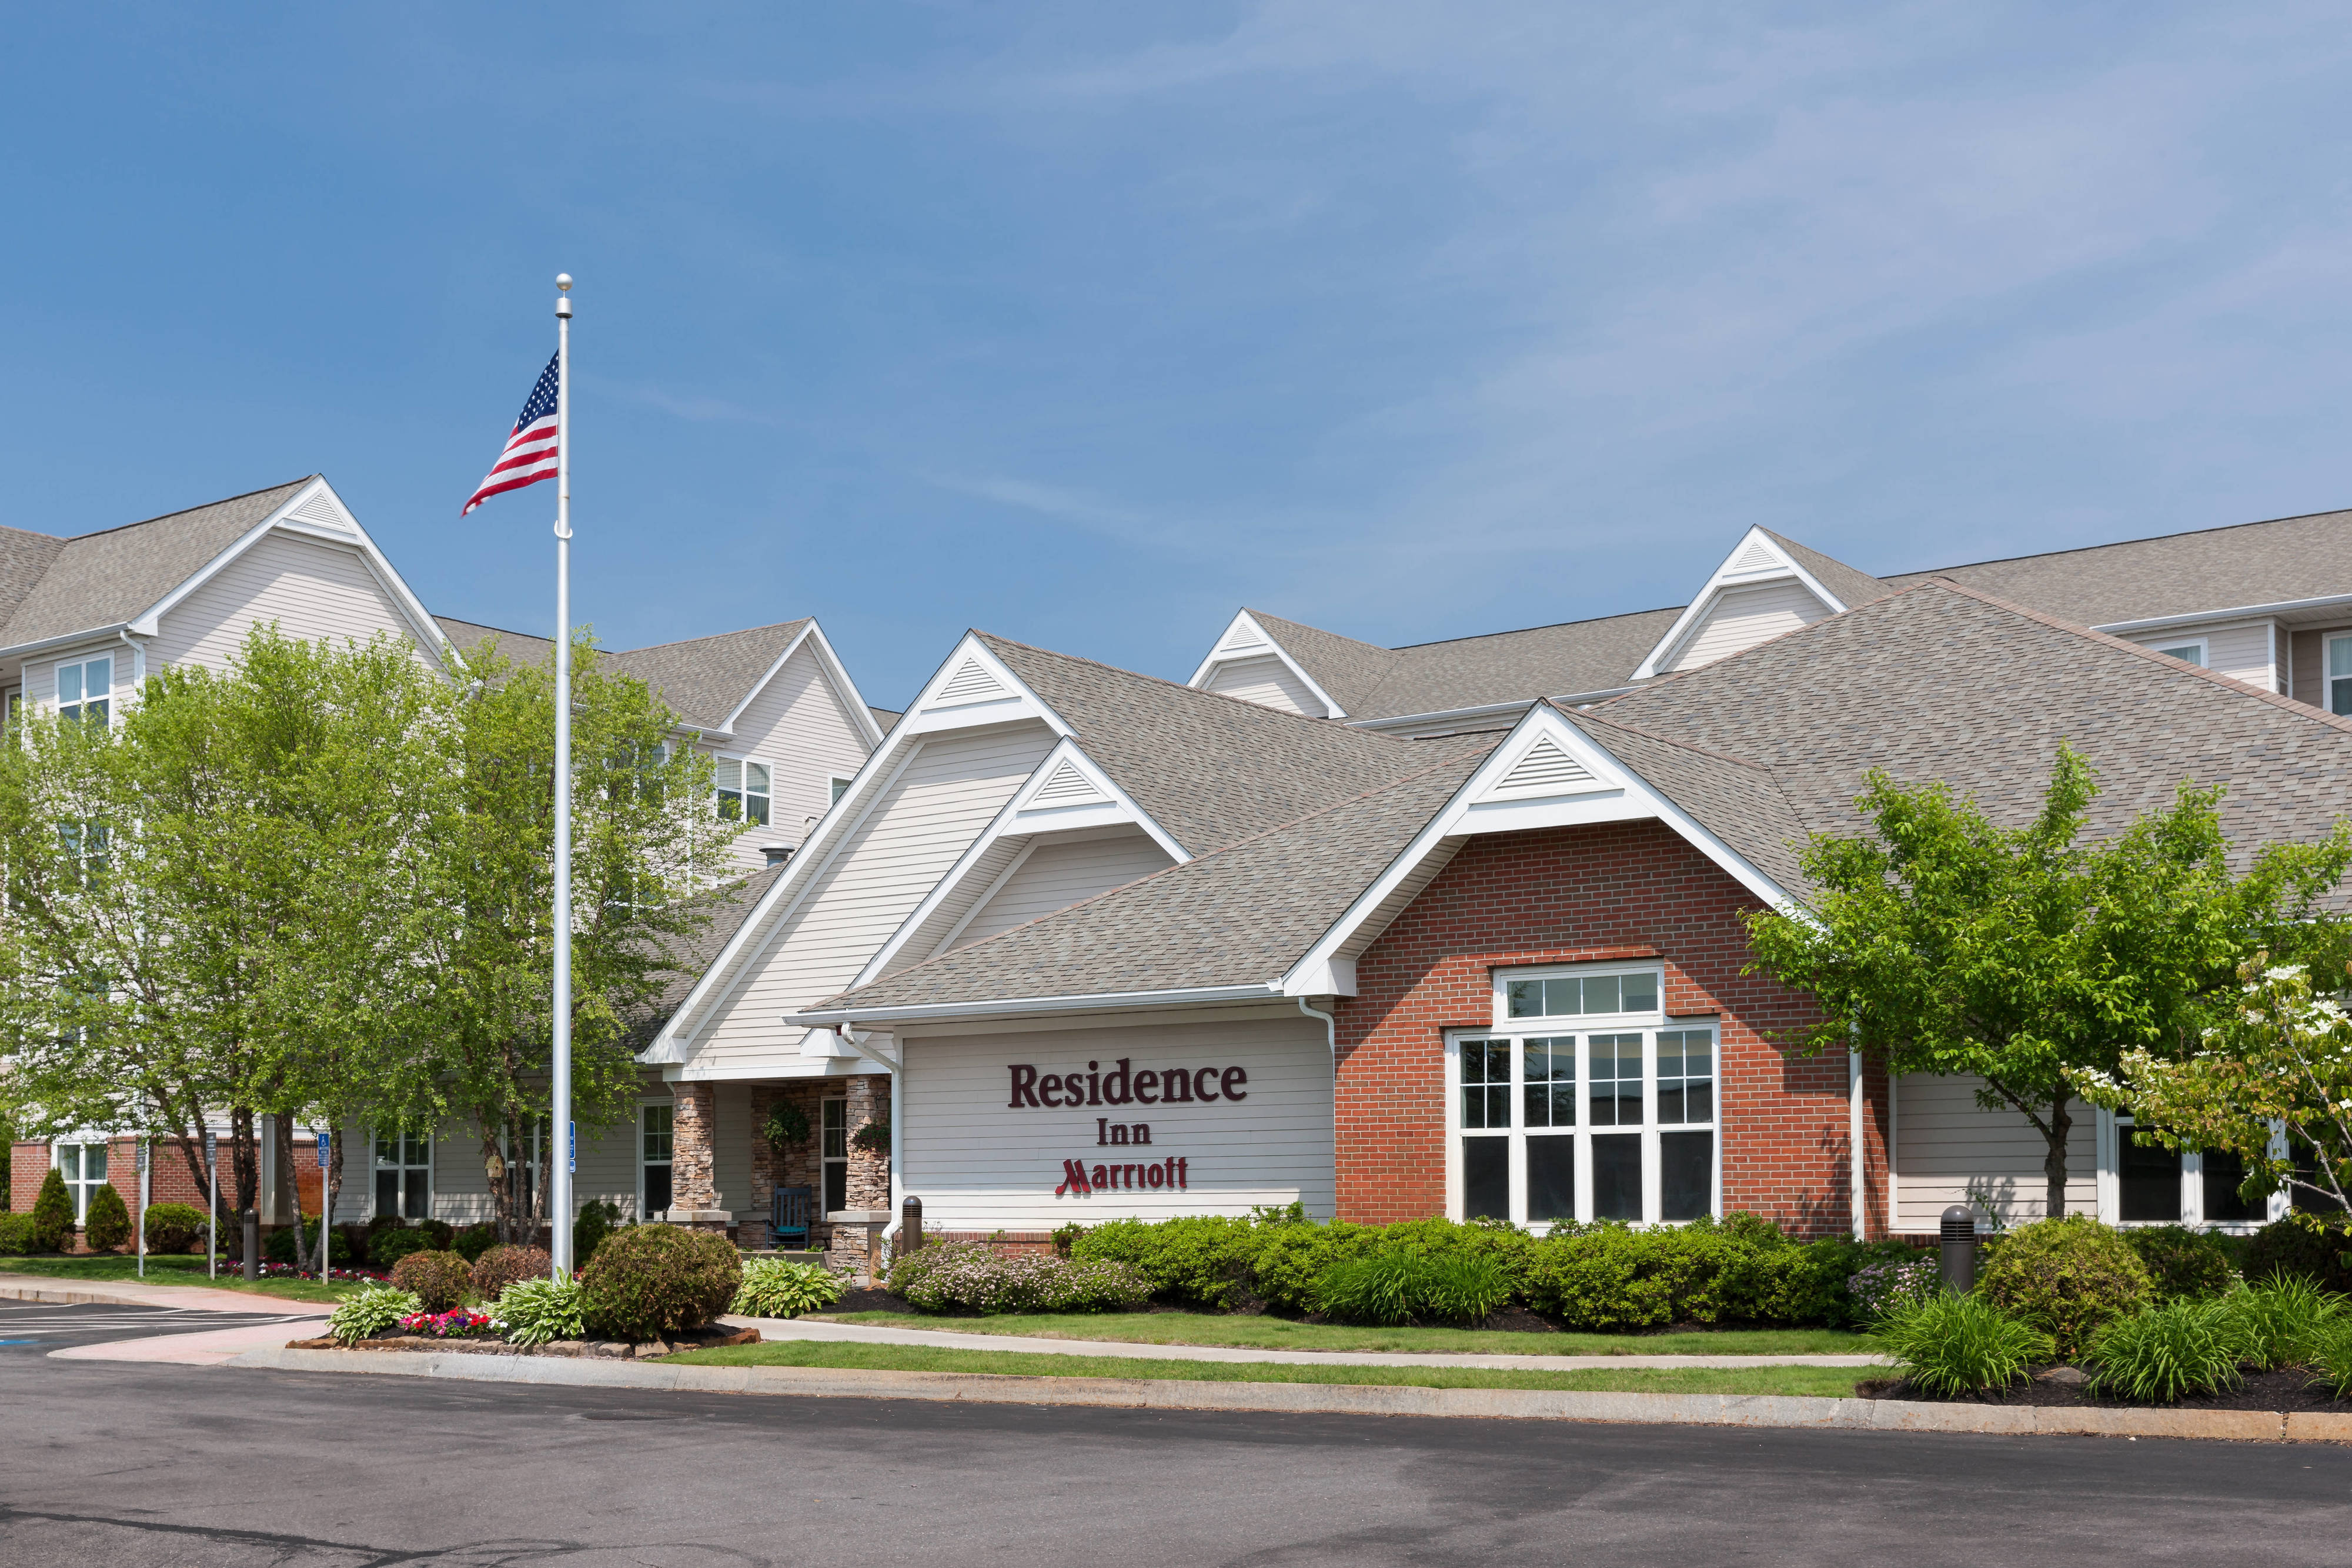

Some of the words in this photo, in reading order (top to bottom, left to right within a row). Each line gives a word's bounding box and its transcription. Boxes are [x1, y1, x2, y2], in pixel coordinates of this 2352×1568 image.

[1008, 1058, 1247, 1108] Residence
[1097, 1118, 1152, 1145] Inn
[1055, 1156, 1188, 1195] Marriott
